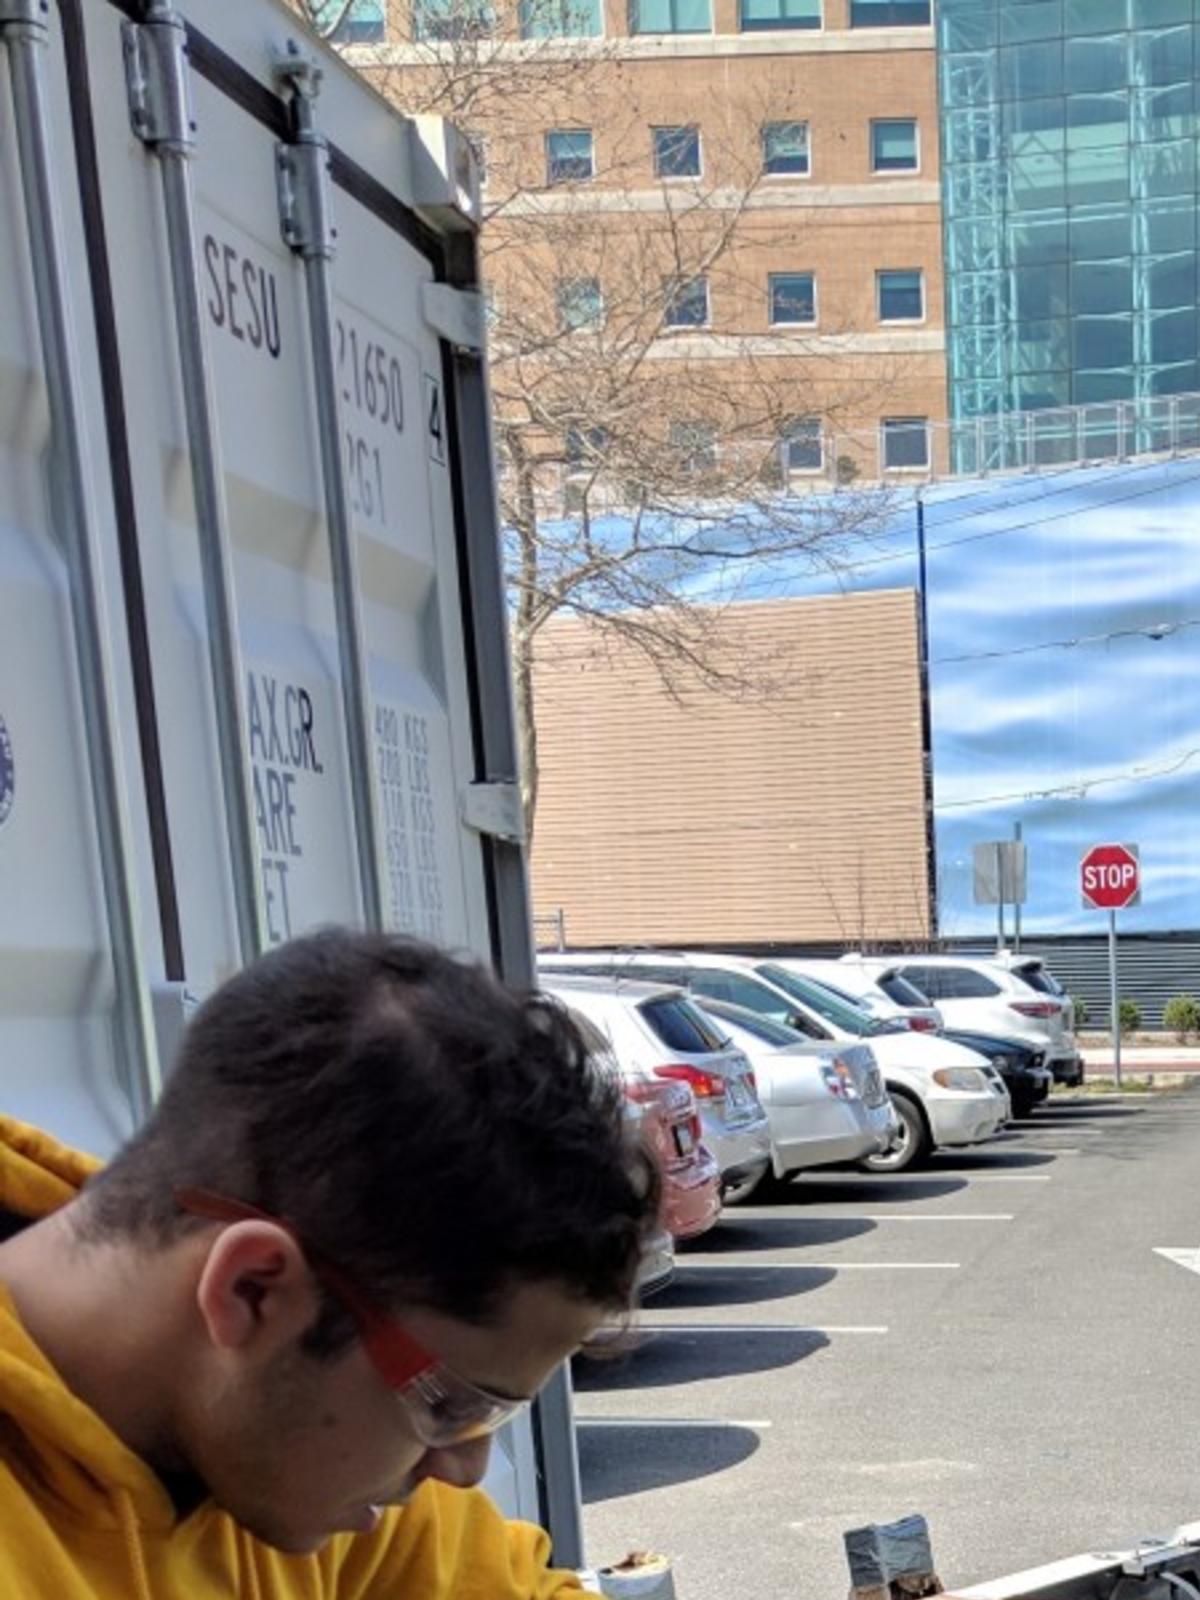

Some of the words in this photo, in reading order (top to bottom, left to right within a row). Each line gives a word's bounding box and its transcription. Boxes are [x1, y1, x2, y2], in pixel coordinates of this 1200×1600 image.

[204, 234, 281, 359] SESU
[428, 385, 444, 459] 4
[250, 672, 323, 774] AX.GR.
[253, 765, 302, 856] ARE
[261, 857, 292, 943] ET
[1084, 864, 1135, 889] STOP
